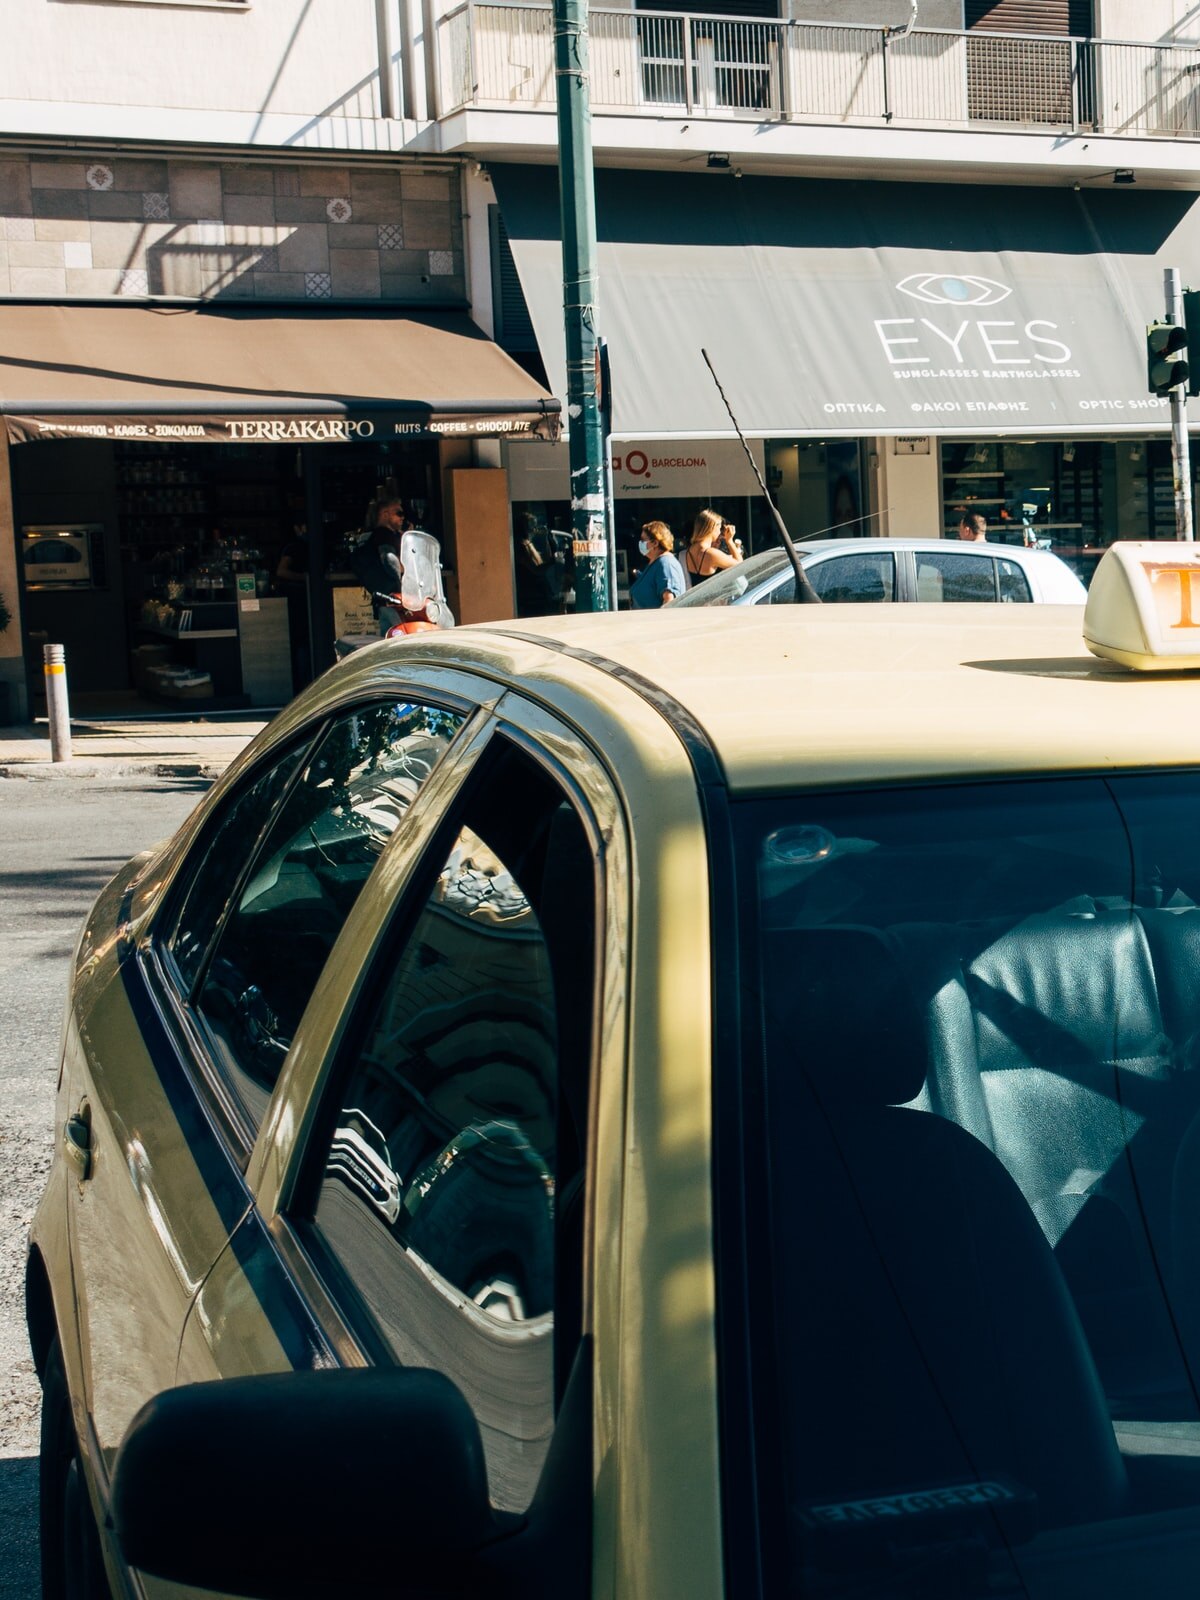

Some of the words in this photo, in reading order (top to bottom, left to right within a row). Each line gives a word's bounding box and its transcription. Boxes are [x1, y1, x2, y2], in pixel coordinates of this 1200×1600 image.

[873, 317, 1072, 365] EYES
[892, 368, 980, 379] SUNGLASSES
[982, 368, 1081, 379] EARTHGLASSES
[823, 402, 887, 414] ΟΠΤΙΚΑ
[910, 402, 962, 413] ΦΑΚΟΙ
[966, 401, 1030, 412] ΕΠΑΦΗΣ
[1078, 400, 1125, 410] OPTIC
[1127, 398, 1169, 409] SHOP
[114, 424, 149, 437] ΚΑΦΕΣ
[155, 424, 206, 436] ΣΟΚΟΛΑΤΑ
[224, 419, 375, 441] TERRAKARPO
[394, 423, 422, 434] NUTS
[429, 421, 468, 433] COFFEE
[475, 420, 532, 432] CHOCOLATE
[651, 457, 707, 468] BARCELONA
